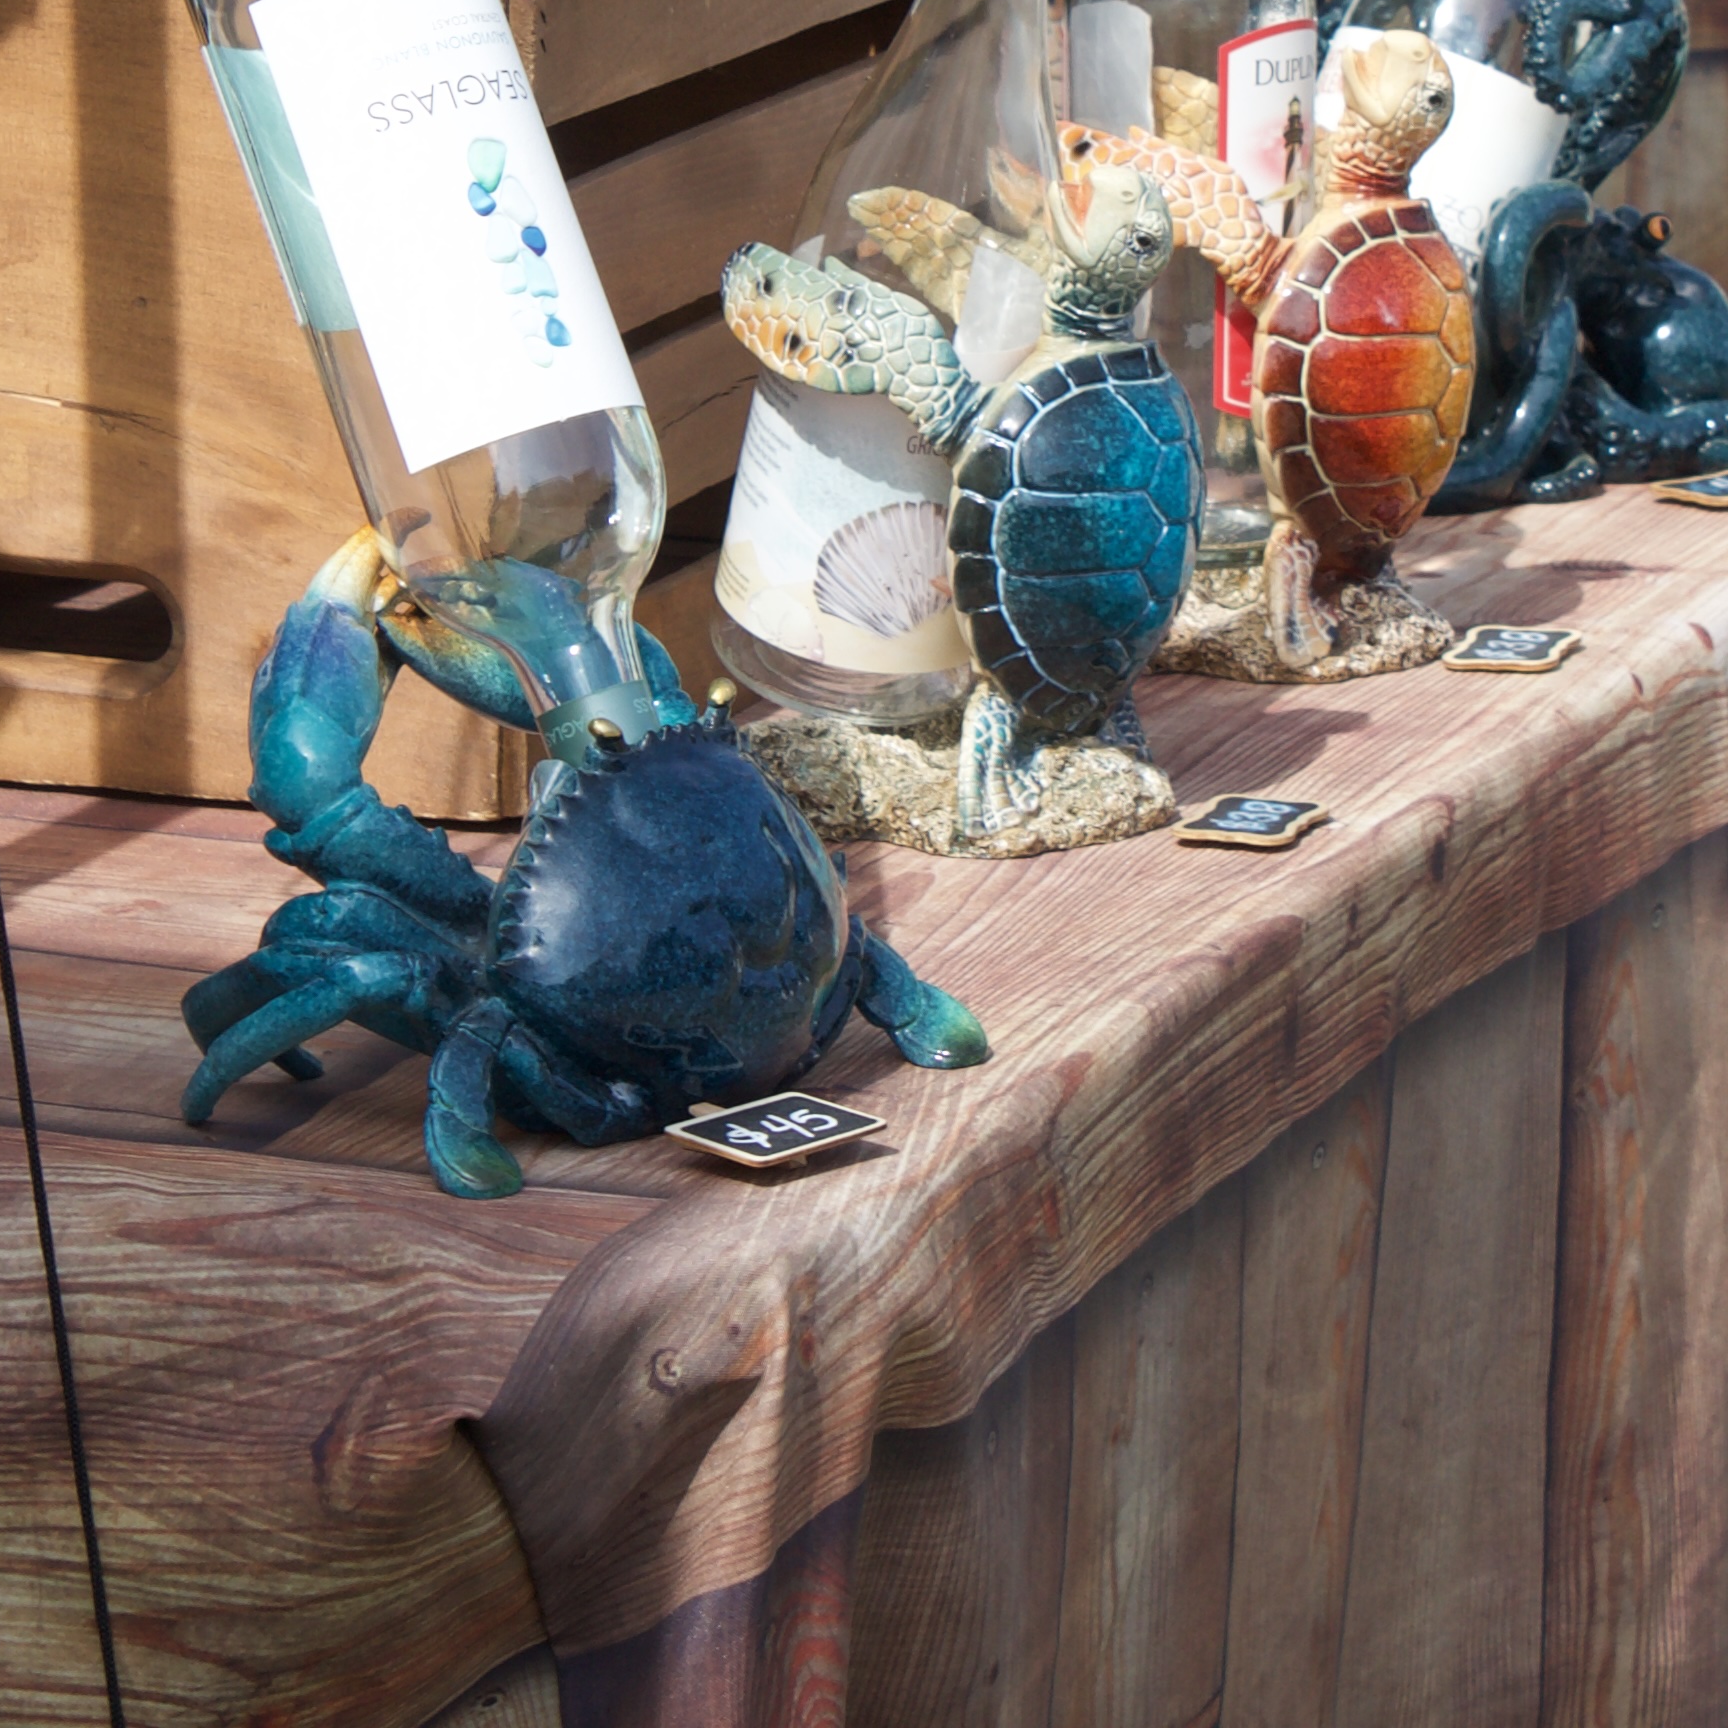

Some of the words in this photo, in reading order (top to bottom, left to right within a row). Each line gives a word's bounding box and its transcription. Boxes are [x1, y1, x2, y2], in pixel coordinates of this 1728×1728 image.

[430, 13, 468, 30] COAST
[436, 31, 509, 51] SAUVIGNON
[373, 44, 430, 68] BLANC
[368, 69, 529, 132] SEAGLASS
[1209, 800, 1298, 832] $38
[725, 1108, 839, 1149] $45
